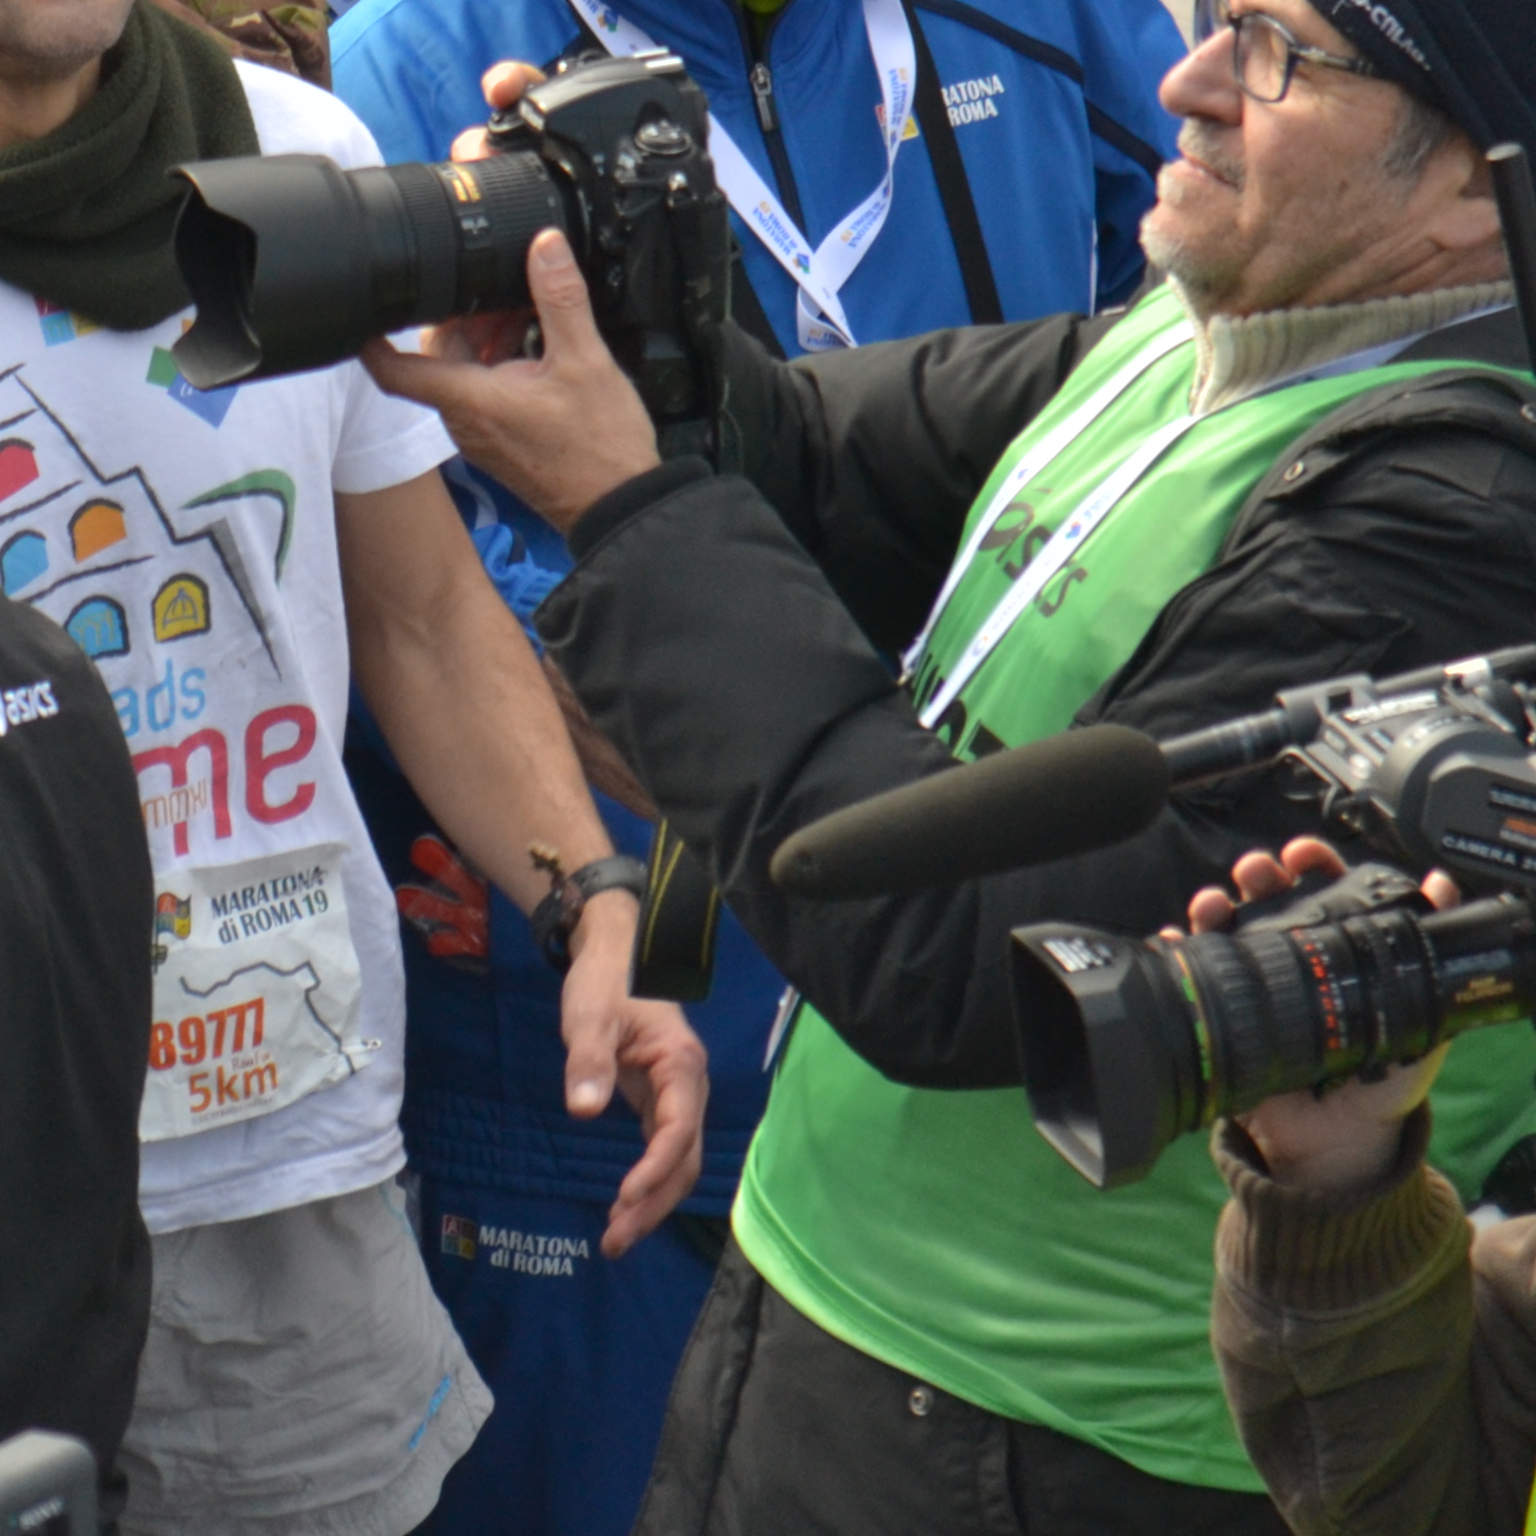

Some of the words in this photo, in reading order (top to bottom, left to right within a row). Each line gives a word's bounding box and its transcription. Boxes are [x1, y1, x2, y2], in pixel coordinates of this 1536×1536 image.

[1442, 834, 1517, 865] CAMERA
[211, 865, 325, 920] MARATONA
[218, 917, 239, 945] di
[240, 896, 303, 938] ROMA
[302, 888, 329, 917] 19
[189, 1060, 278, 1113] 5km
[479, 1225, 590, 1259] MARATONA
[490, 1249, 510, 1268] di
[513, 1251, 574, 1277] ROMA
